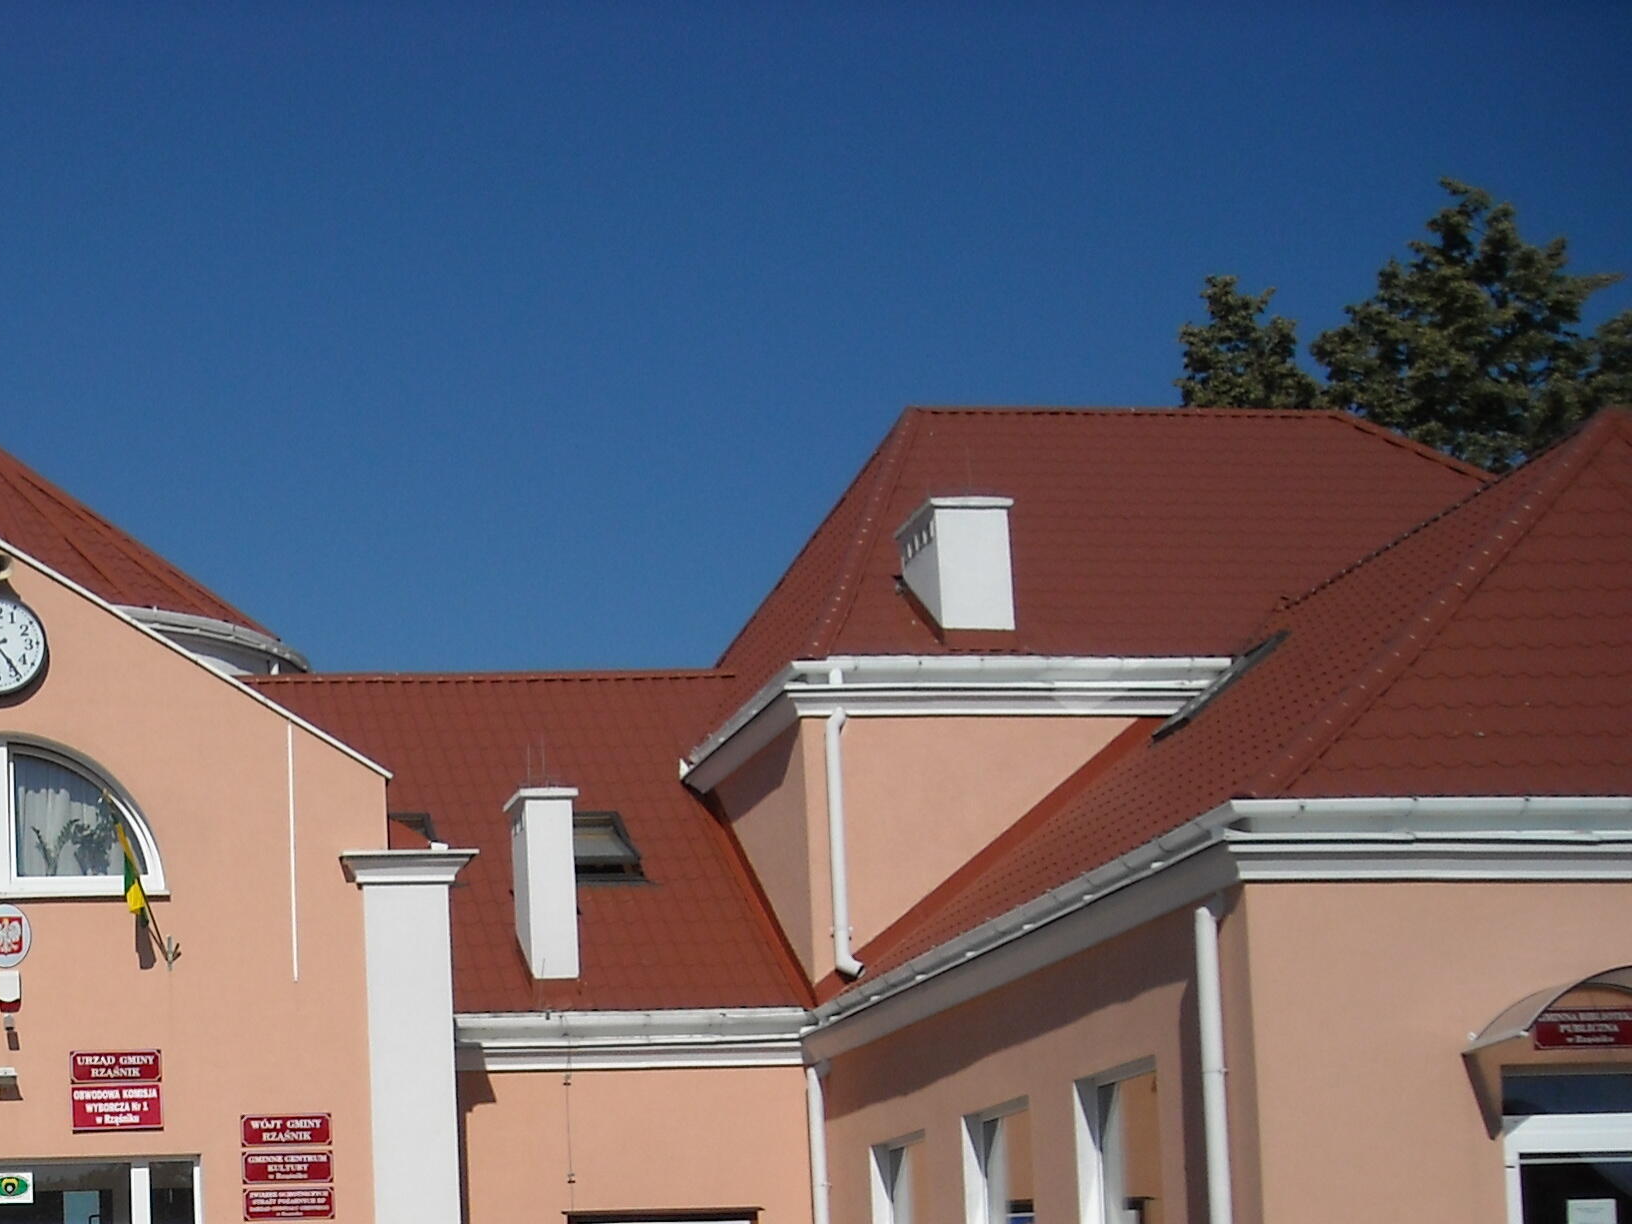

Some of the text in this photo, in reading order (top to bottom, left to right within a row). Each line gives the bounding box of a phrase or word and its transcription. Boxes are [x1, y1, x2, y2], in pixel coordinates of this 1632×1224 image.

[9, 611, 15, 624] 1
[20, 625, 29, 636] 2
[24, 639, 33, 650] 3
[18, 654, 27, 665] 4
[9, 665, 18, 678] 5
[76, 1055, 154, 1066] URZĄD GMINY
[91, 1065, 141, 1078] RZĄŚNIK
[73, 1088, 158, 1100] OBWODOWA KOMISJA
[85, 1101, 149, 1113] WYBORCZA Nr 1
[95, 1116, 103, 1124] w
[250, 1118, 322, 1129] WÓJT GMINY
[262, 1130, 312, 1142] RZĄŚNIK
